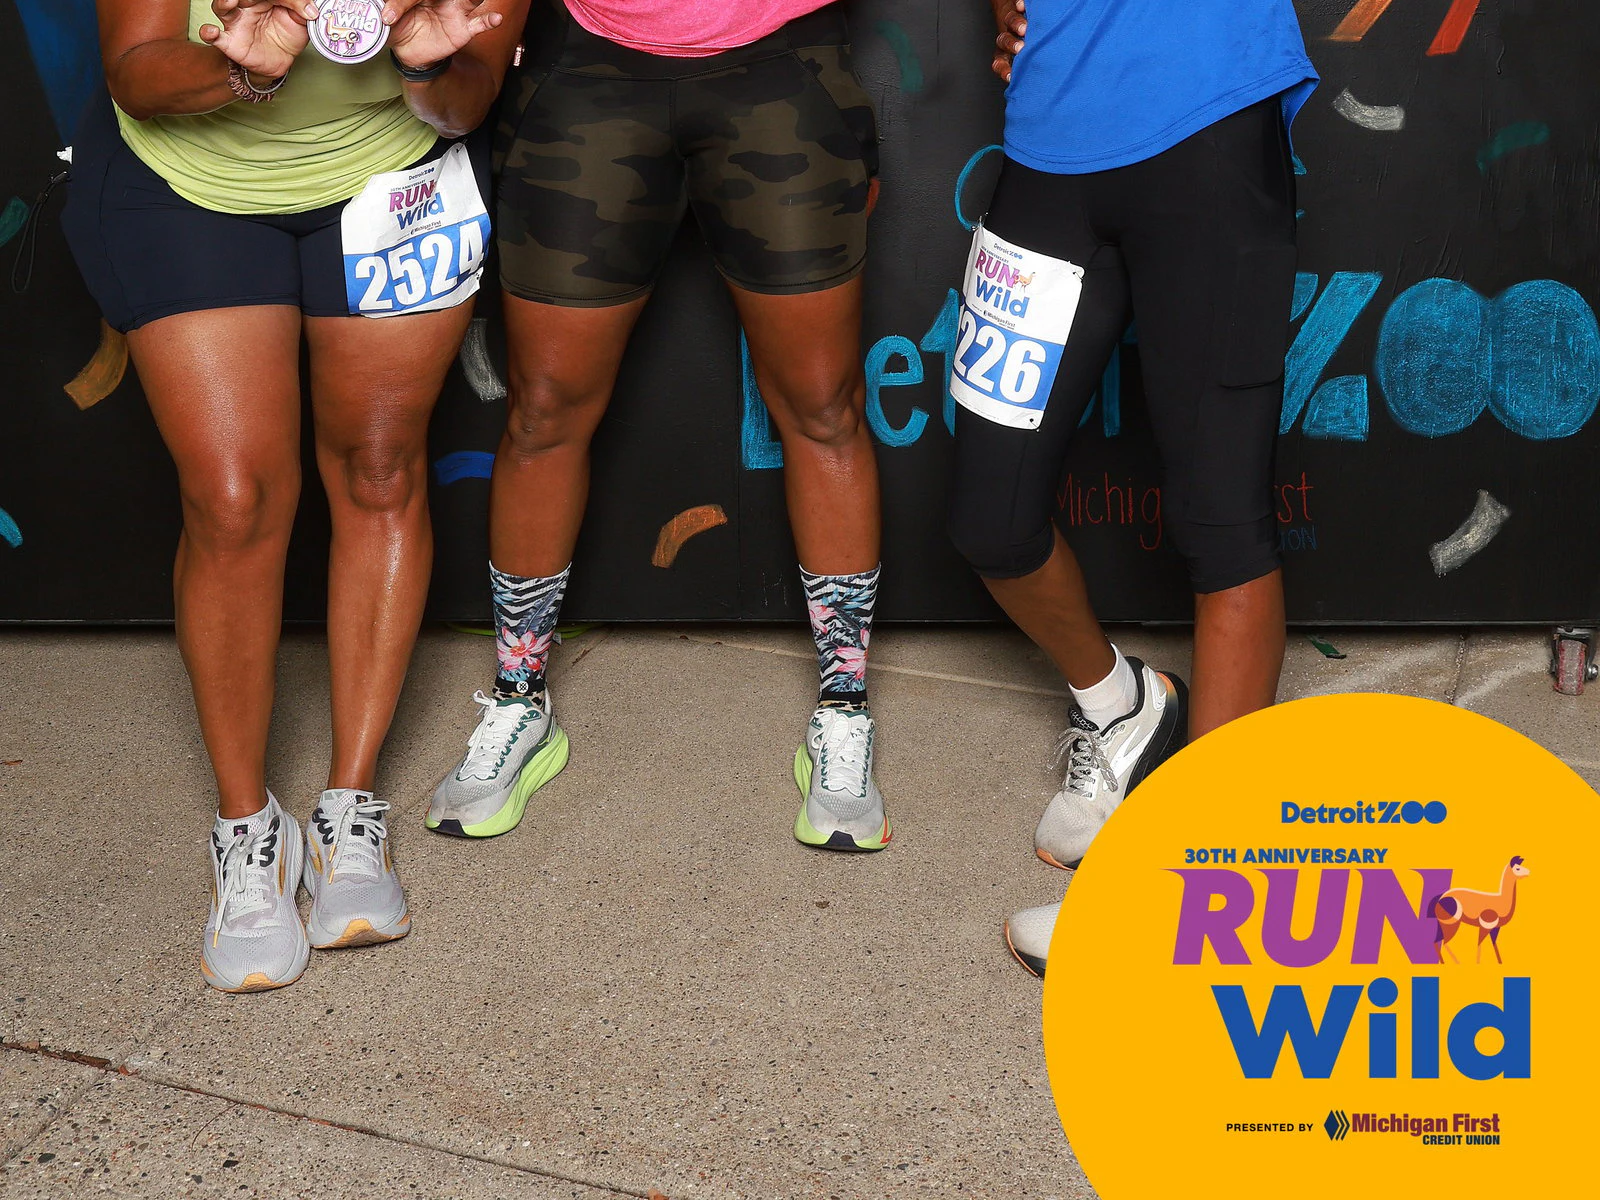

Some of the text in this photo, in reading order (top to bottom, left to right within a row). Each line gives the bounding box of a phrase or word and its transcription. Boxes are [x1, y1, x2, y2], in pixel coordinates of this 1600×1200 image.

[335, 11, 378, 34] Wild
[388, 179, 436, 212] RUN
[396, 192, 445, 230] Wild
[355, 220, 485, 311] 2524
[975, 248, 1020, 289] RUN
[975, 275, 1030, 319] Wild
